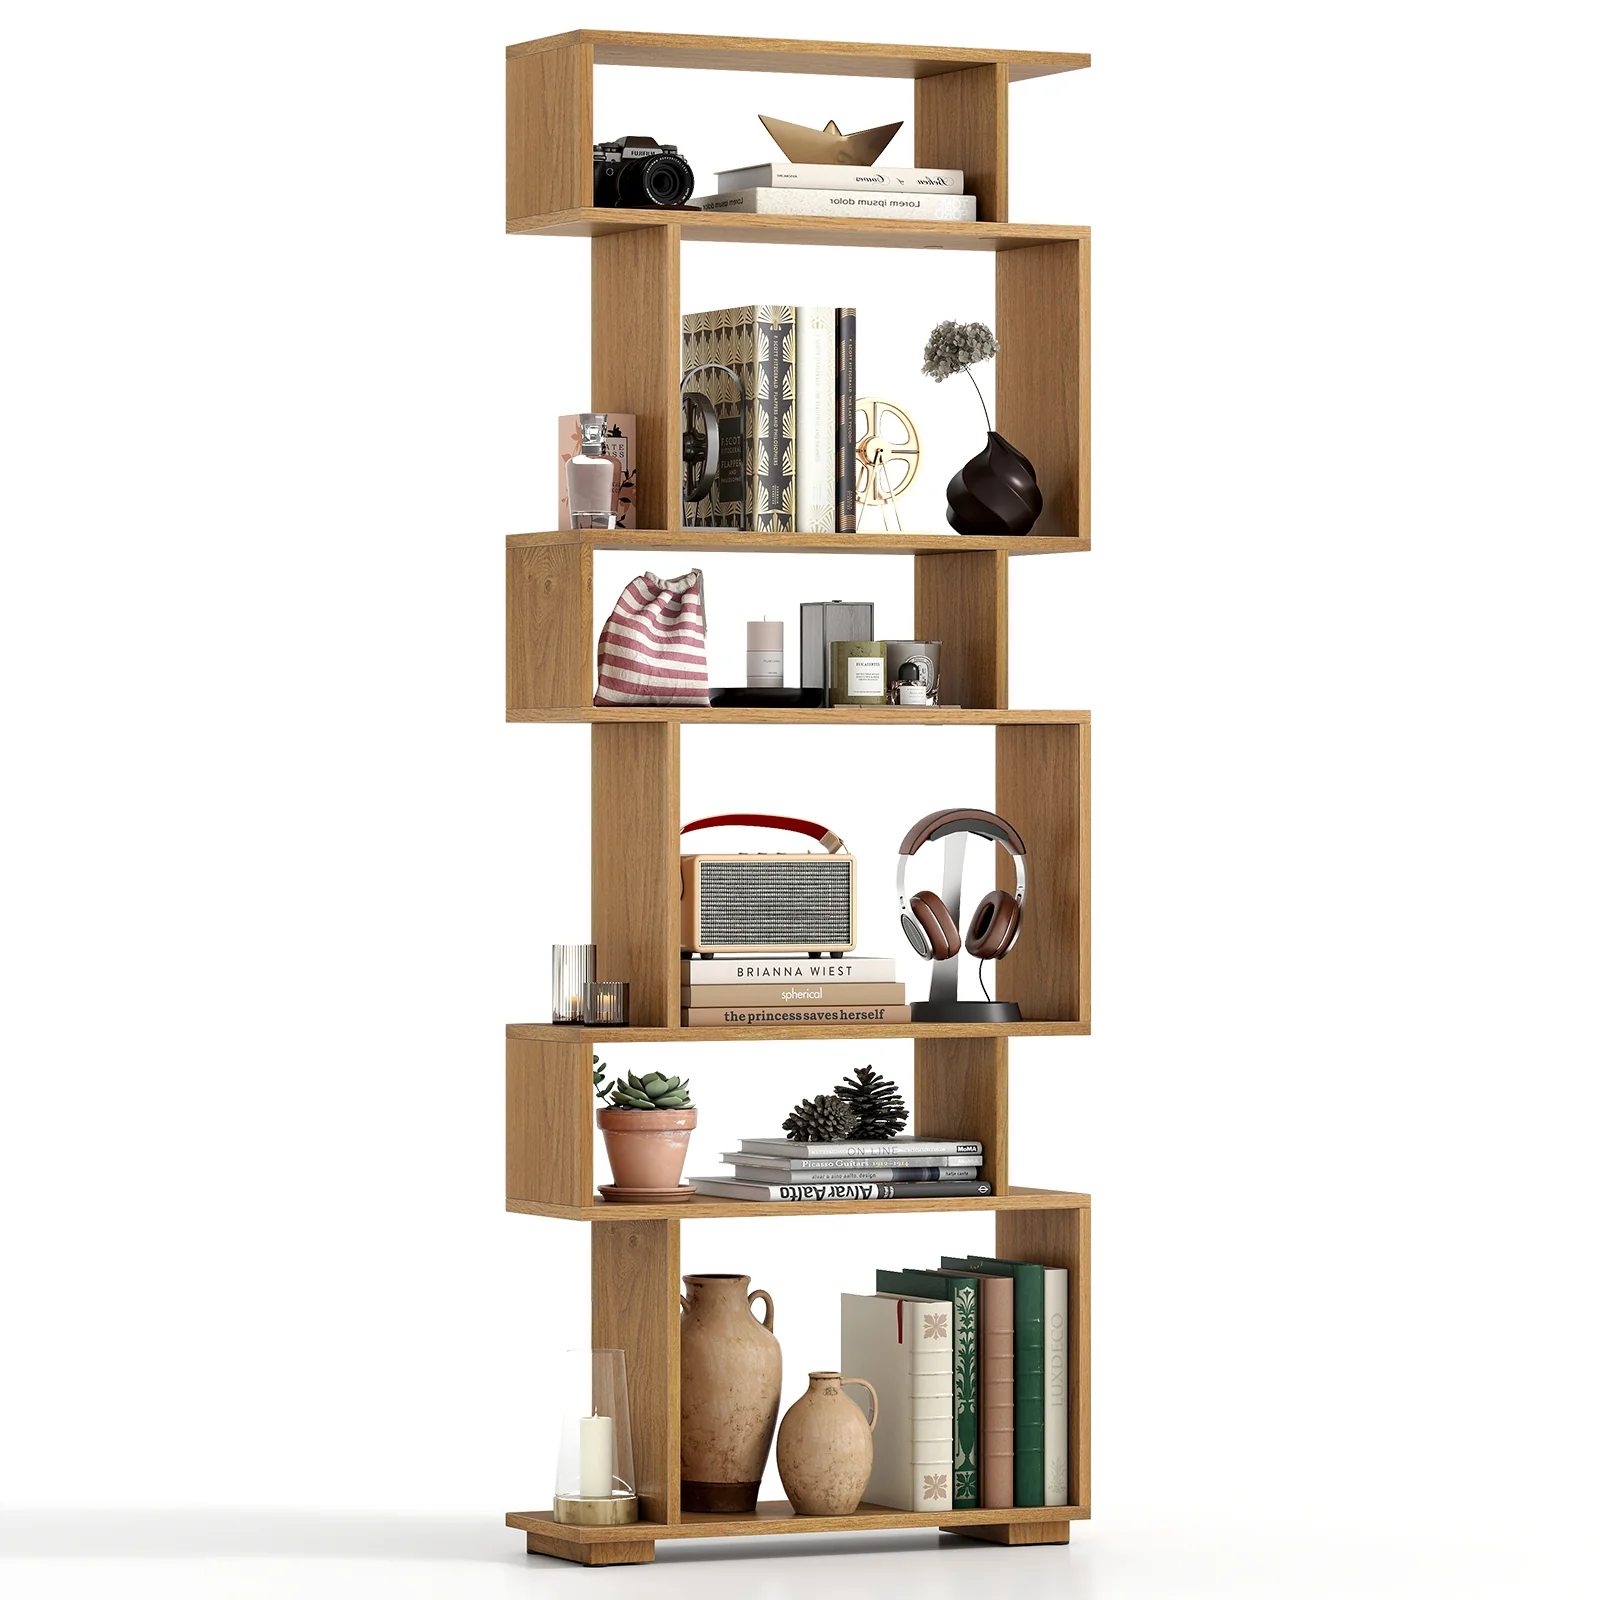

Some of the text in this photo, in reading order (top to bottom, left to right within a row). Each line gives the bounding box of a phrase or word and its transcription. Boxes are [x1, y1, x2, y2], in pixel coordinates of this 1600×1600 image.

[737, 965, 853, 977] BRIANNA WIEST
[781, 987, 823, 1001] spherical
[724, 1009, 885, 1024] the princess saves herself
[847, 1147, 866, 1157] ON
[871, 1146, 899, 1156] LINE
[957, 1145, 978, 1153] MoMA
[802, 1159, 834, 1168] Picasso
[835, 1158, 869, 1168] Guitars
[1050, 1313, 1064, 1407] LUXDECO
